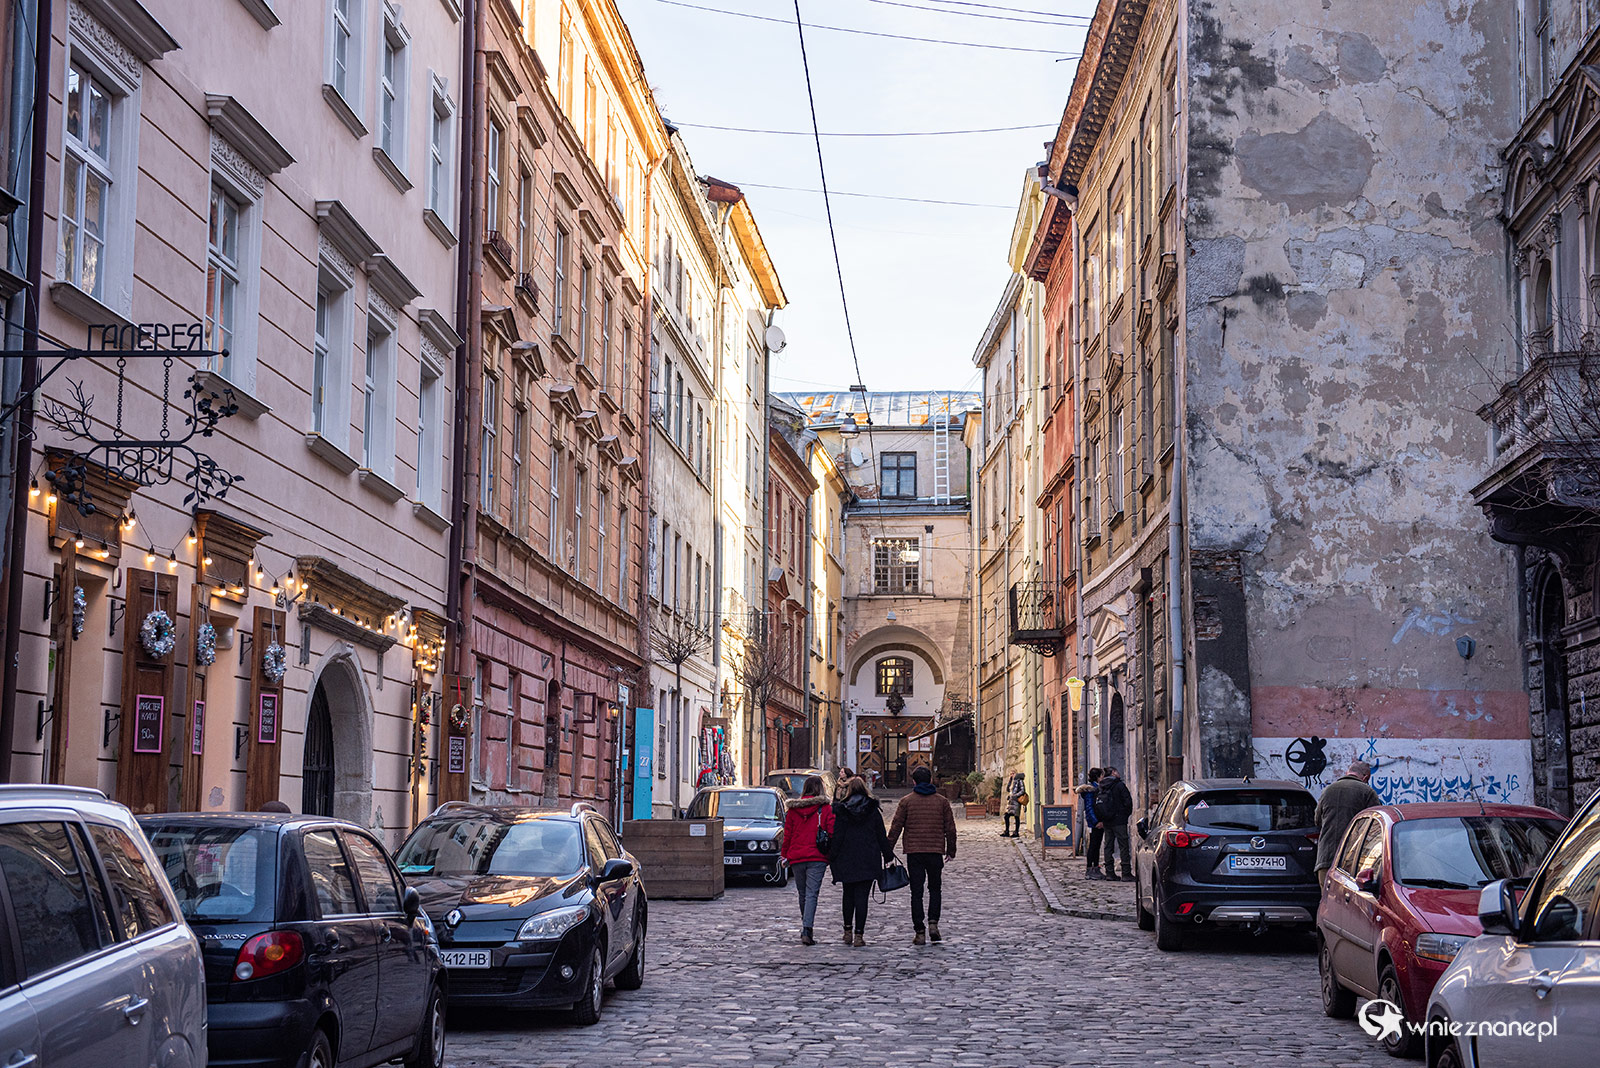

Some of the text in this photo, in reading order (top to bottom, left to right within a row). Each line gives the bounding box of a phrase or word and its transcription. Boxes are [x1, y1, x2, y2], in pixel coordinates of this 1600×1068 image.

[88, 323, 203, 350] ГАЛЕРЕЯ
[1506, 774, 1519, 791] 16
[469, 953, 486, 966] HB
